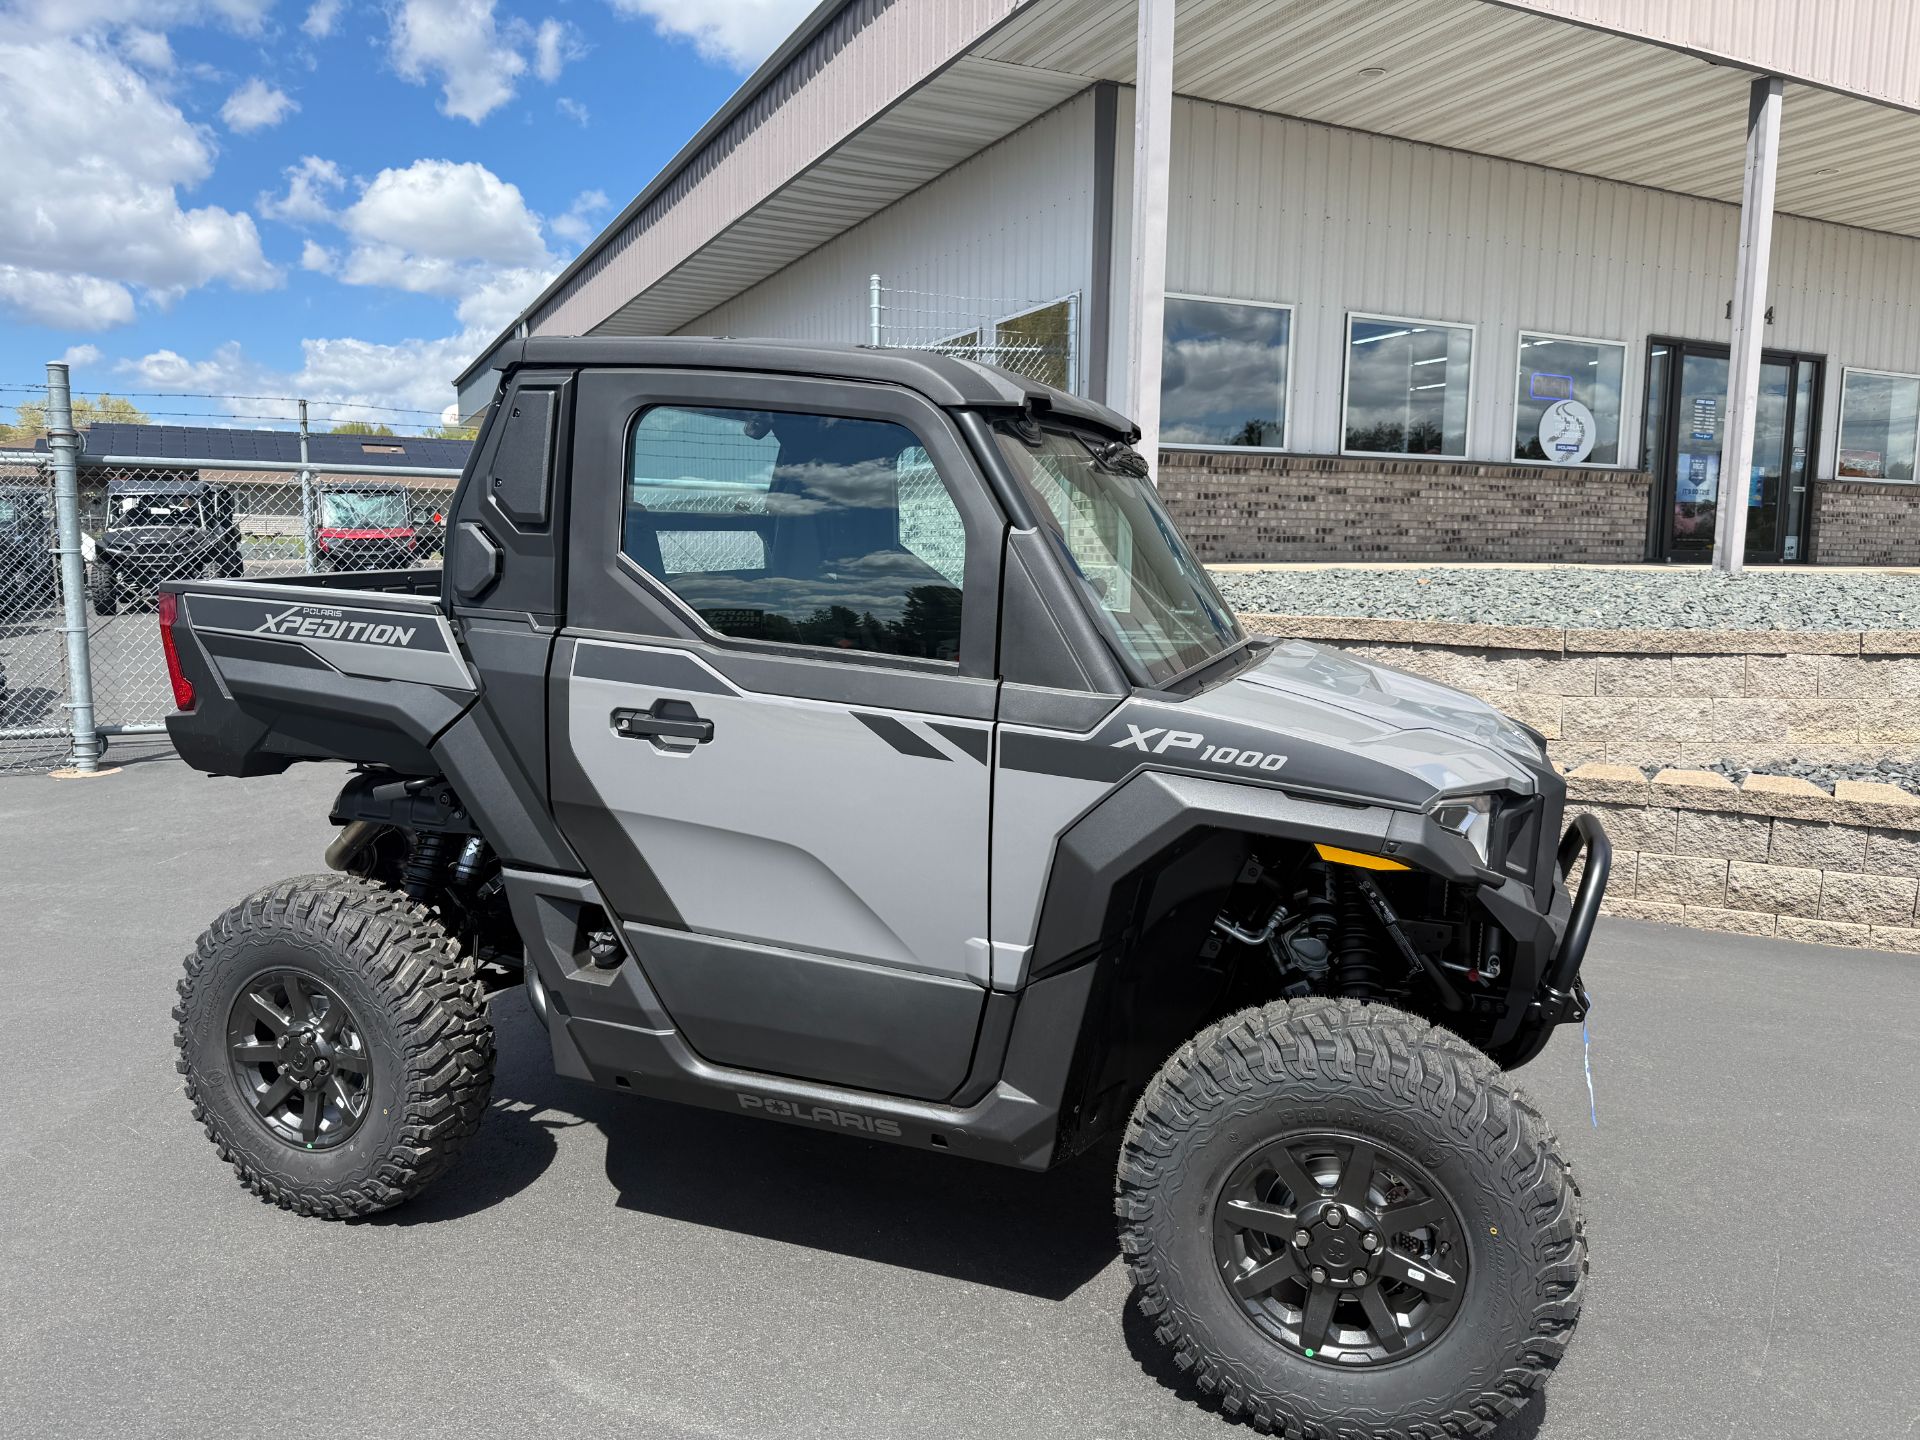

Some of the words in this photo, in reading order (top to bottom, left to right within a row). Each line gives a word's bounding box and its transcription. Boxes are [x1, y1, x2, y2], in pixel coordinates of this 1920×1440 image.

[252, 606, 416, 646] XPEDITION
[303, 607, 342, 617] POLARIS
[1109, 723, 1204, 754] XP
[1200, 745, 1289, 771] 1000
[737, 1093, 902, 1137] POLARIS
